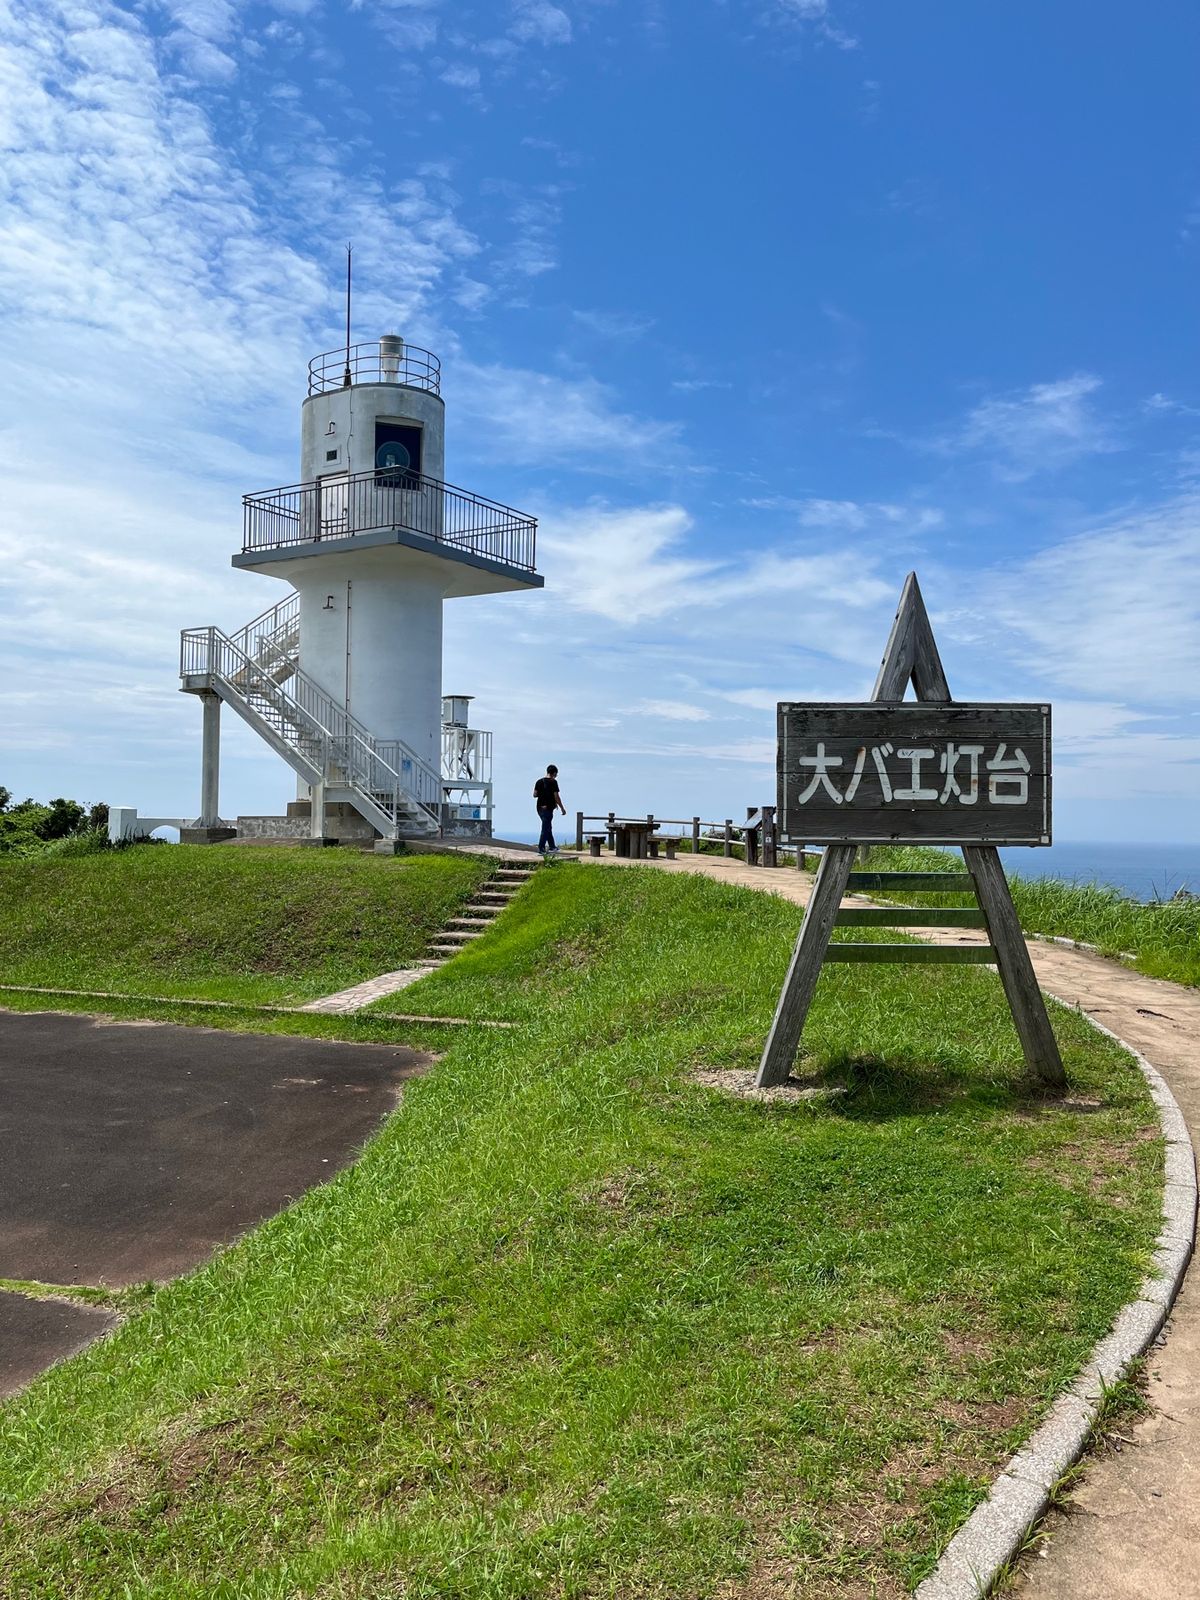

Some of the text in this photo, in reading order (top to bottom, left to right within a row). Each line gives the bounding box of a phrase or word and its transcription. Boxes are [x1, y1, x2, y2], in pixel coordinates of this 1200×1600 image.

[798, 742, 1030, 804] 大バエ灯台
